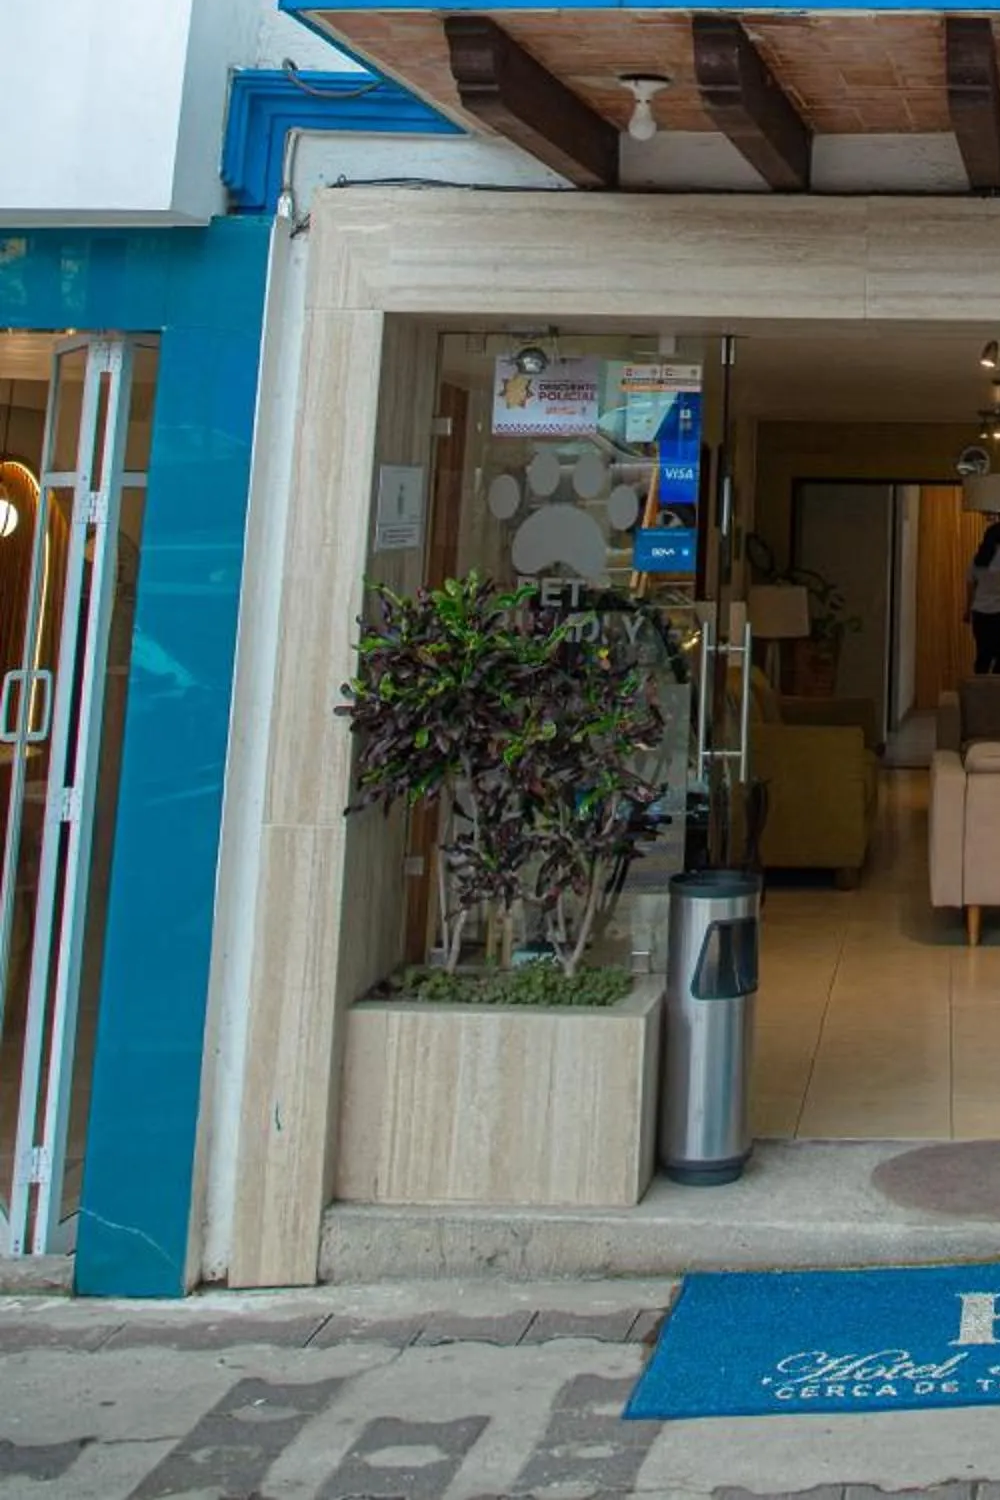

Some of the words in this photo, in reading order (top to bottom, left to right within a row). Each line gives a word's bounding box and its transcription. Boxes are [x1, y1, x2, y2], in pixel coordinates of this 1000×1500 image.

[664, 467, 694, 479] VISA
[762, 1349, 968, 1385] Hotel
[775, 1383, 898, 1400] CERCA
[914, 1380, 959, 1395] DE
